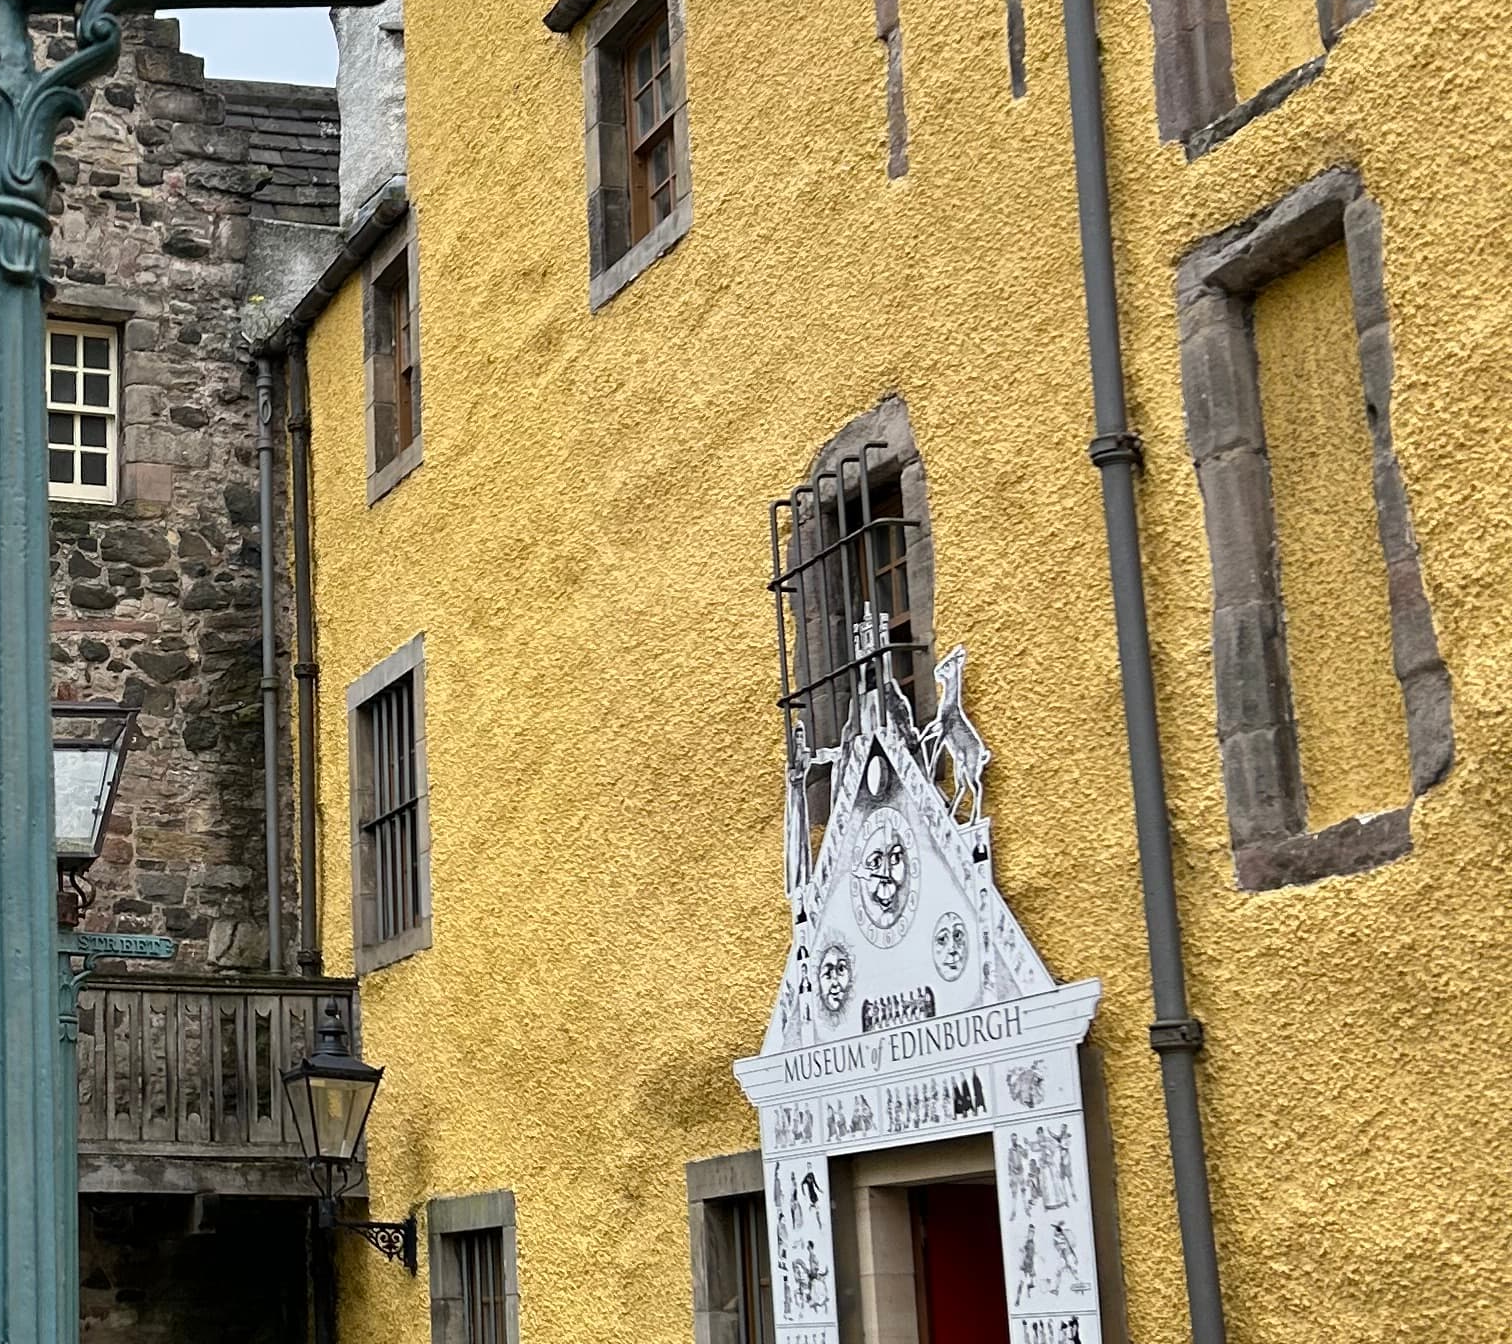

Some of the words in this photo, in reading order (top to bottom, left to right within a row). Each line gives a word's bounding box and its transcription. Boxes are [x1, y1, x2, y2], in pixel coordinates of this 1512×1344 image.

[77, 935, 161, 956] STREET
[783, 1042, 866, 1084] MUSEUM
[870, 1036, 886, 1073] of
[889, 1005, 1024, 1062] EDINBURGH
